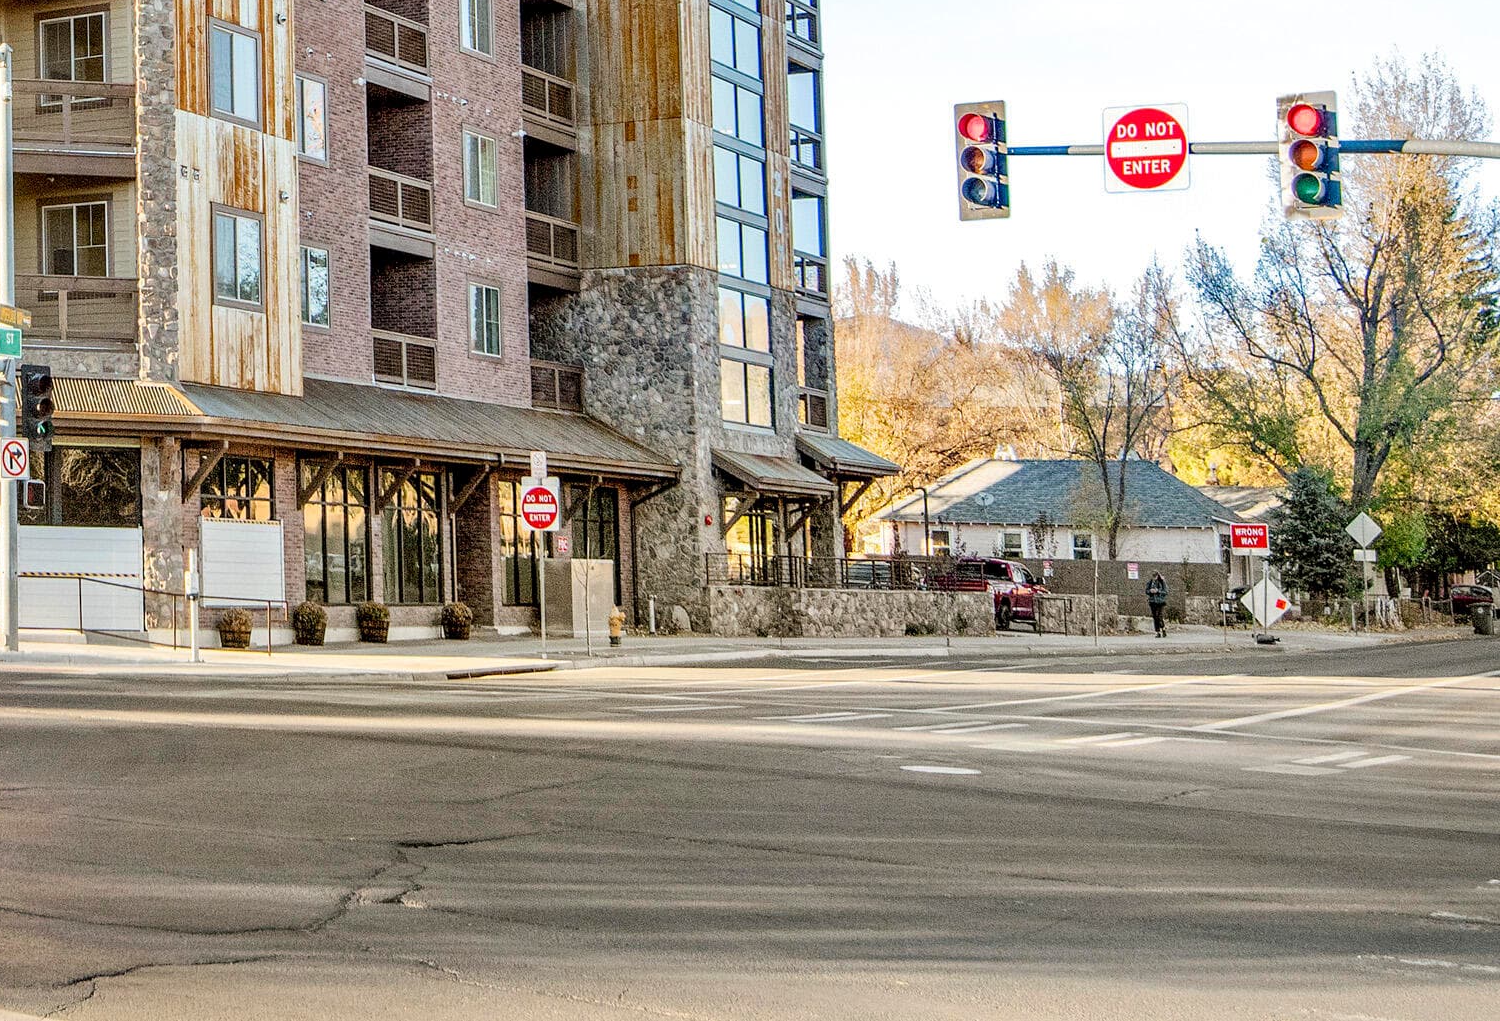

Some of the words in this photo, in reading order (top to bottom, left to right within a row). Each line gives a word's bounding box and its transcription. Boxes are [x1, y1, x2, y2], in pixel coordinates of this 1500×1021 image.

[1116, 123, 1138, 138] DO
[1145, 121, 1176, 137] NOT
[1123, 159, 1171, 175] ENTER
[6, 332, 14, 345] ST
[526, 494, 536, 503] DO
[538, 494, 552, 503] NOT
[529, 513, 551, 522] ENTER
[1234, 527, 1264, 536] WRONG
[1240, 537, 1258, 545] WAY
